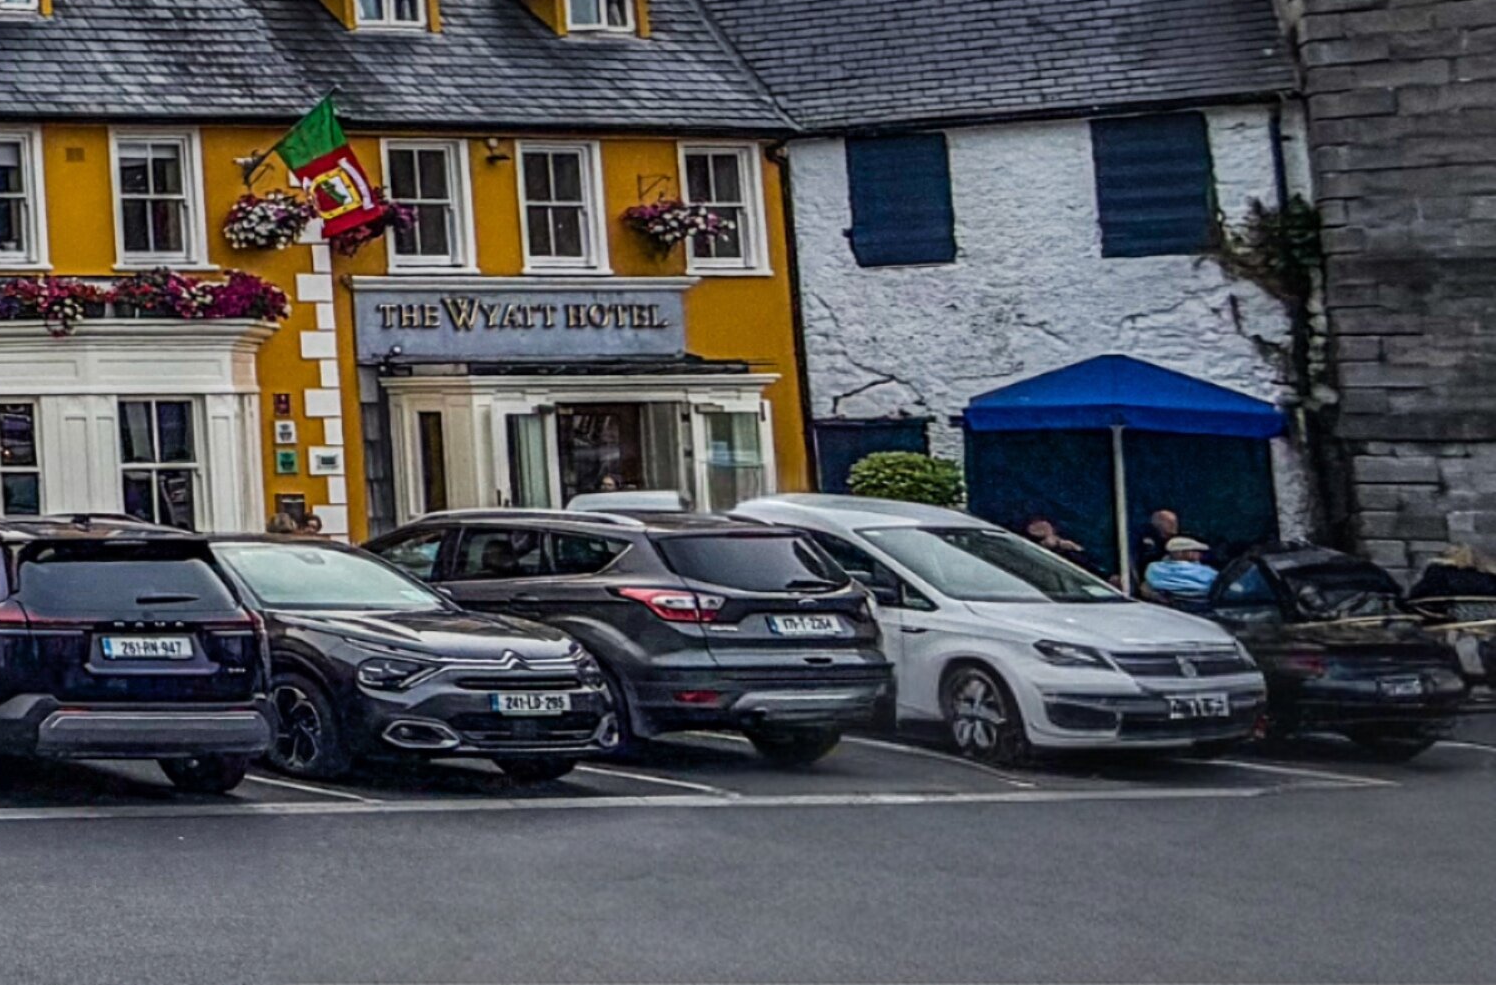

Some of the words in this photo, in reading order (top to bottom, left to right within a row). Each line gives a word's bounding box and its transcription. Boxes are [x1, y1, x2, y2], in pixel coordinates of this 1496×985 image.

[375, 303, 441, 329] THE
[441, 295, 558, 331] WYATT
[563, 302, 670, 331] HOTEL
